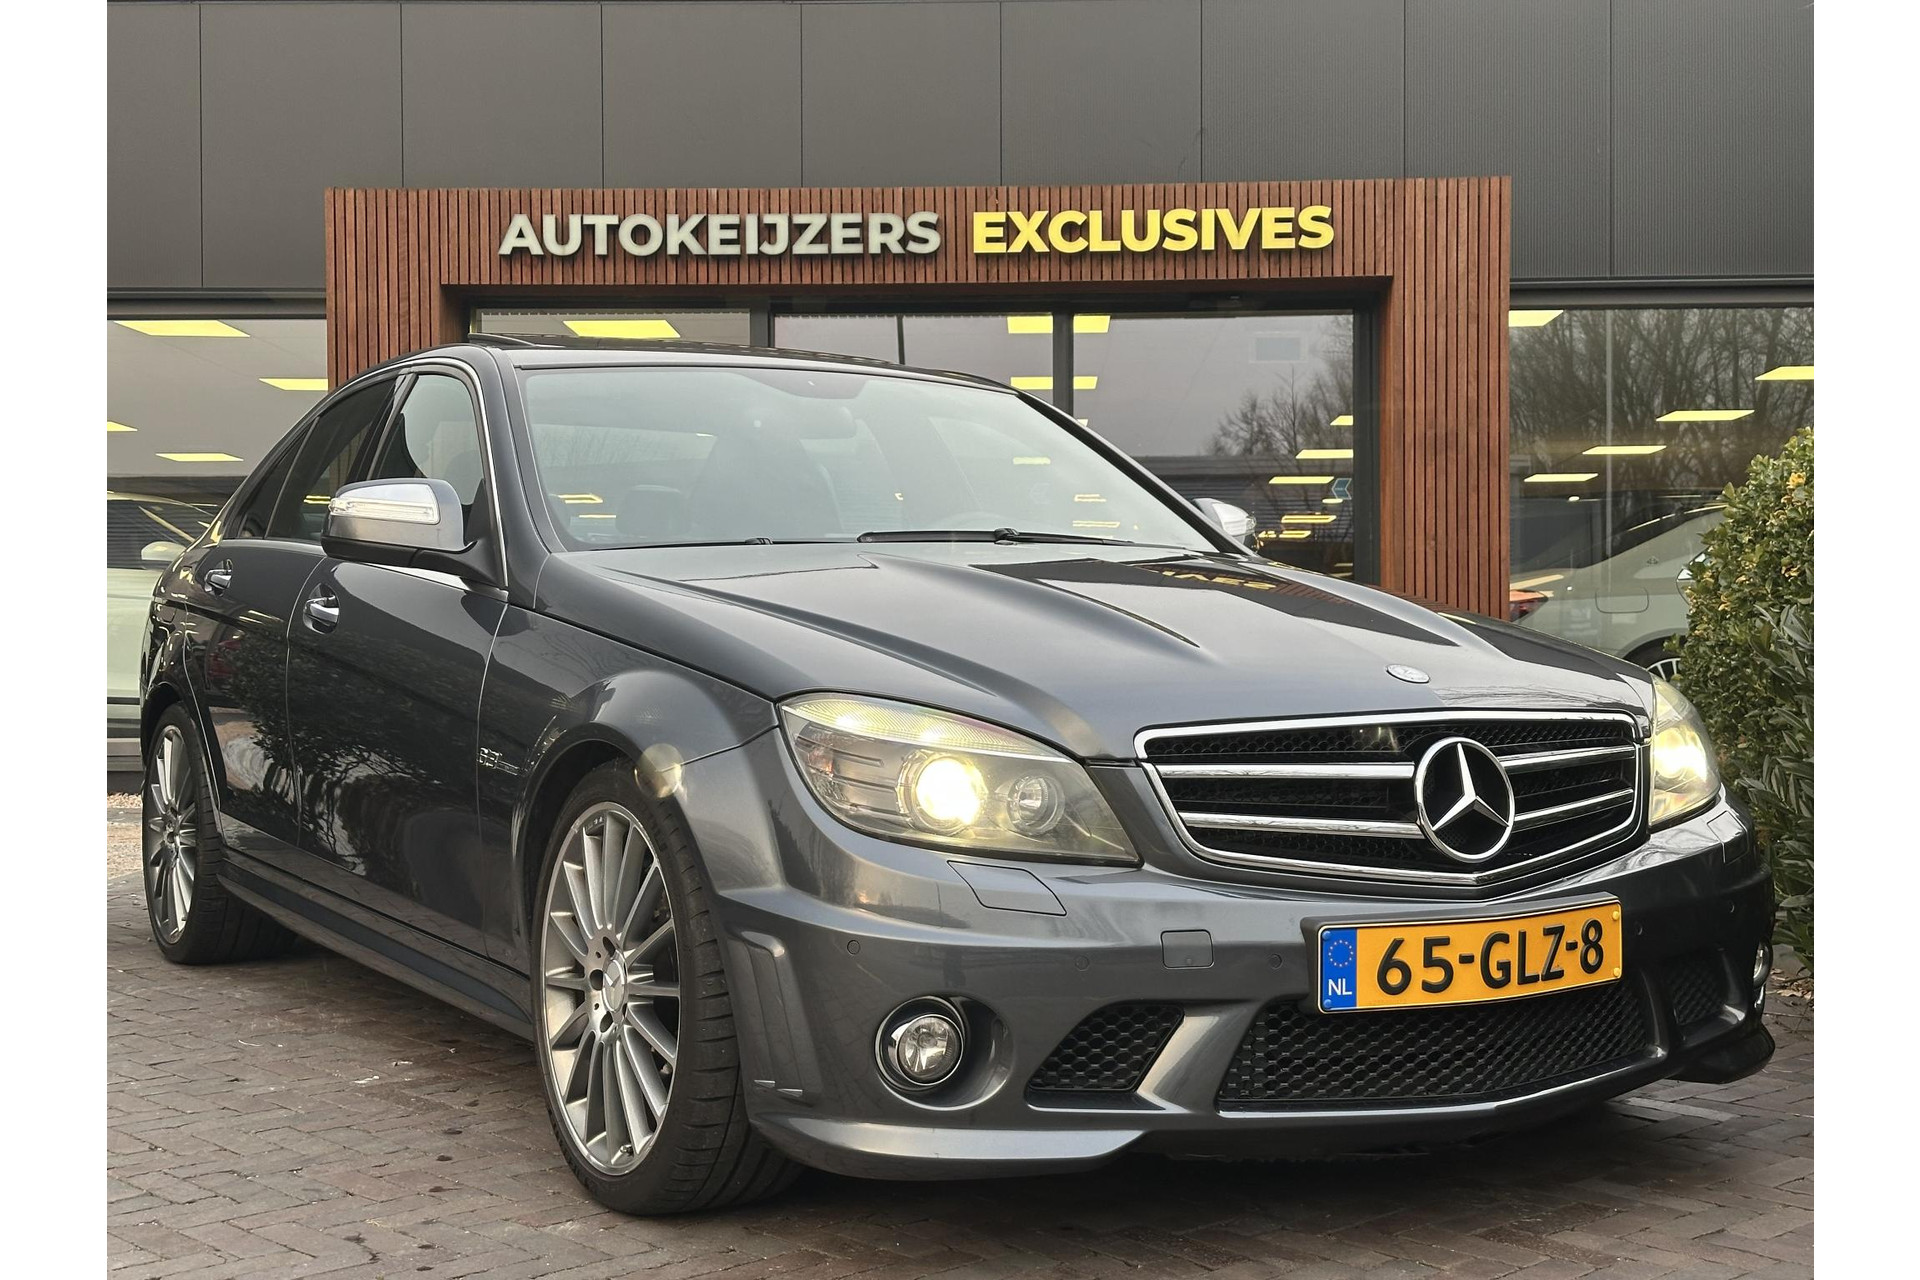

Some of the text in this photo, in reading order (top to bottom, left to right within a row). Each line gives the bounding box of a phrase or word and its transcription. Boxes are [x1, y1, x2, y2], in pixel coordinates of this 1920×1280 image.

[498, 205, 1335, 257] AUTOKEIJZERS EXCLUSIVES
[1376, 918, 1604, 996] 65-GLZ-8
[1328, 978, 1352, 995] NL
